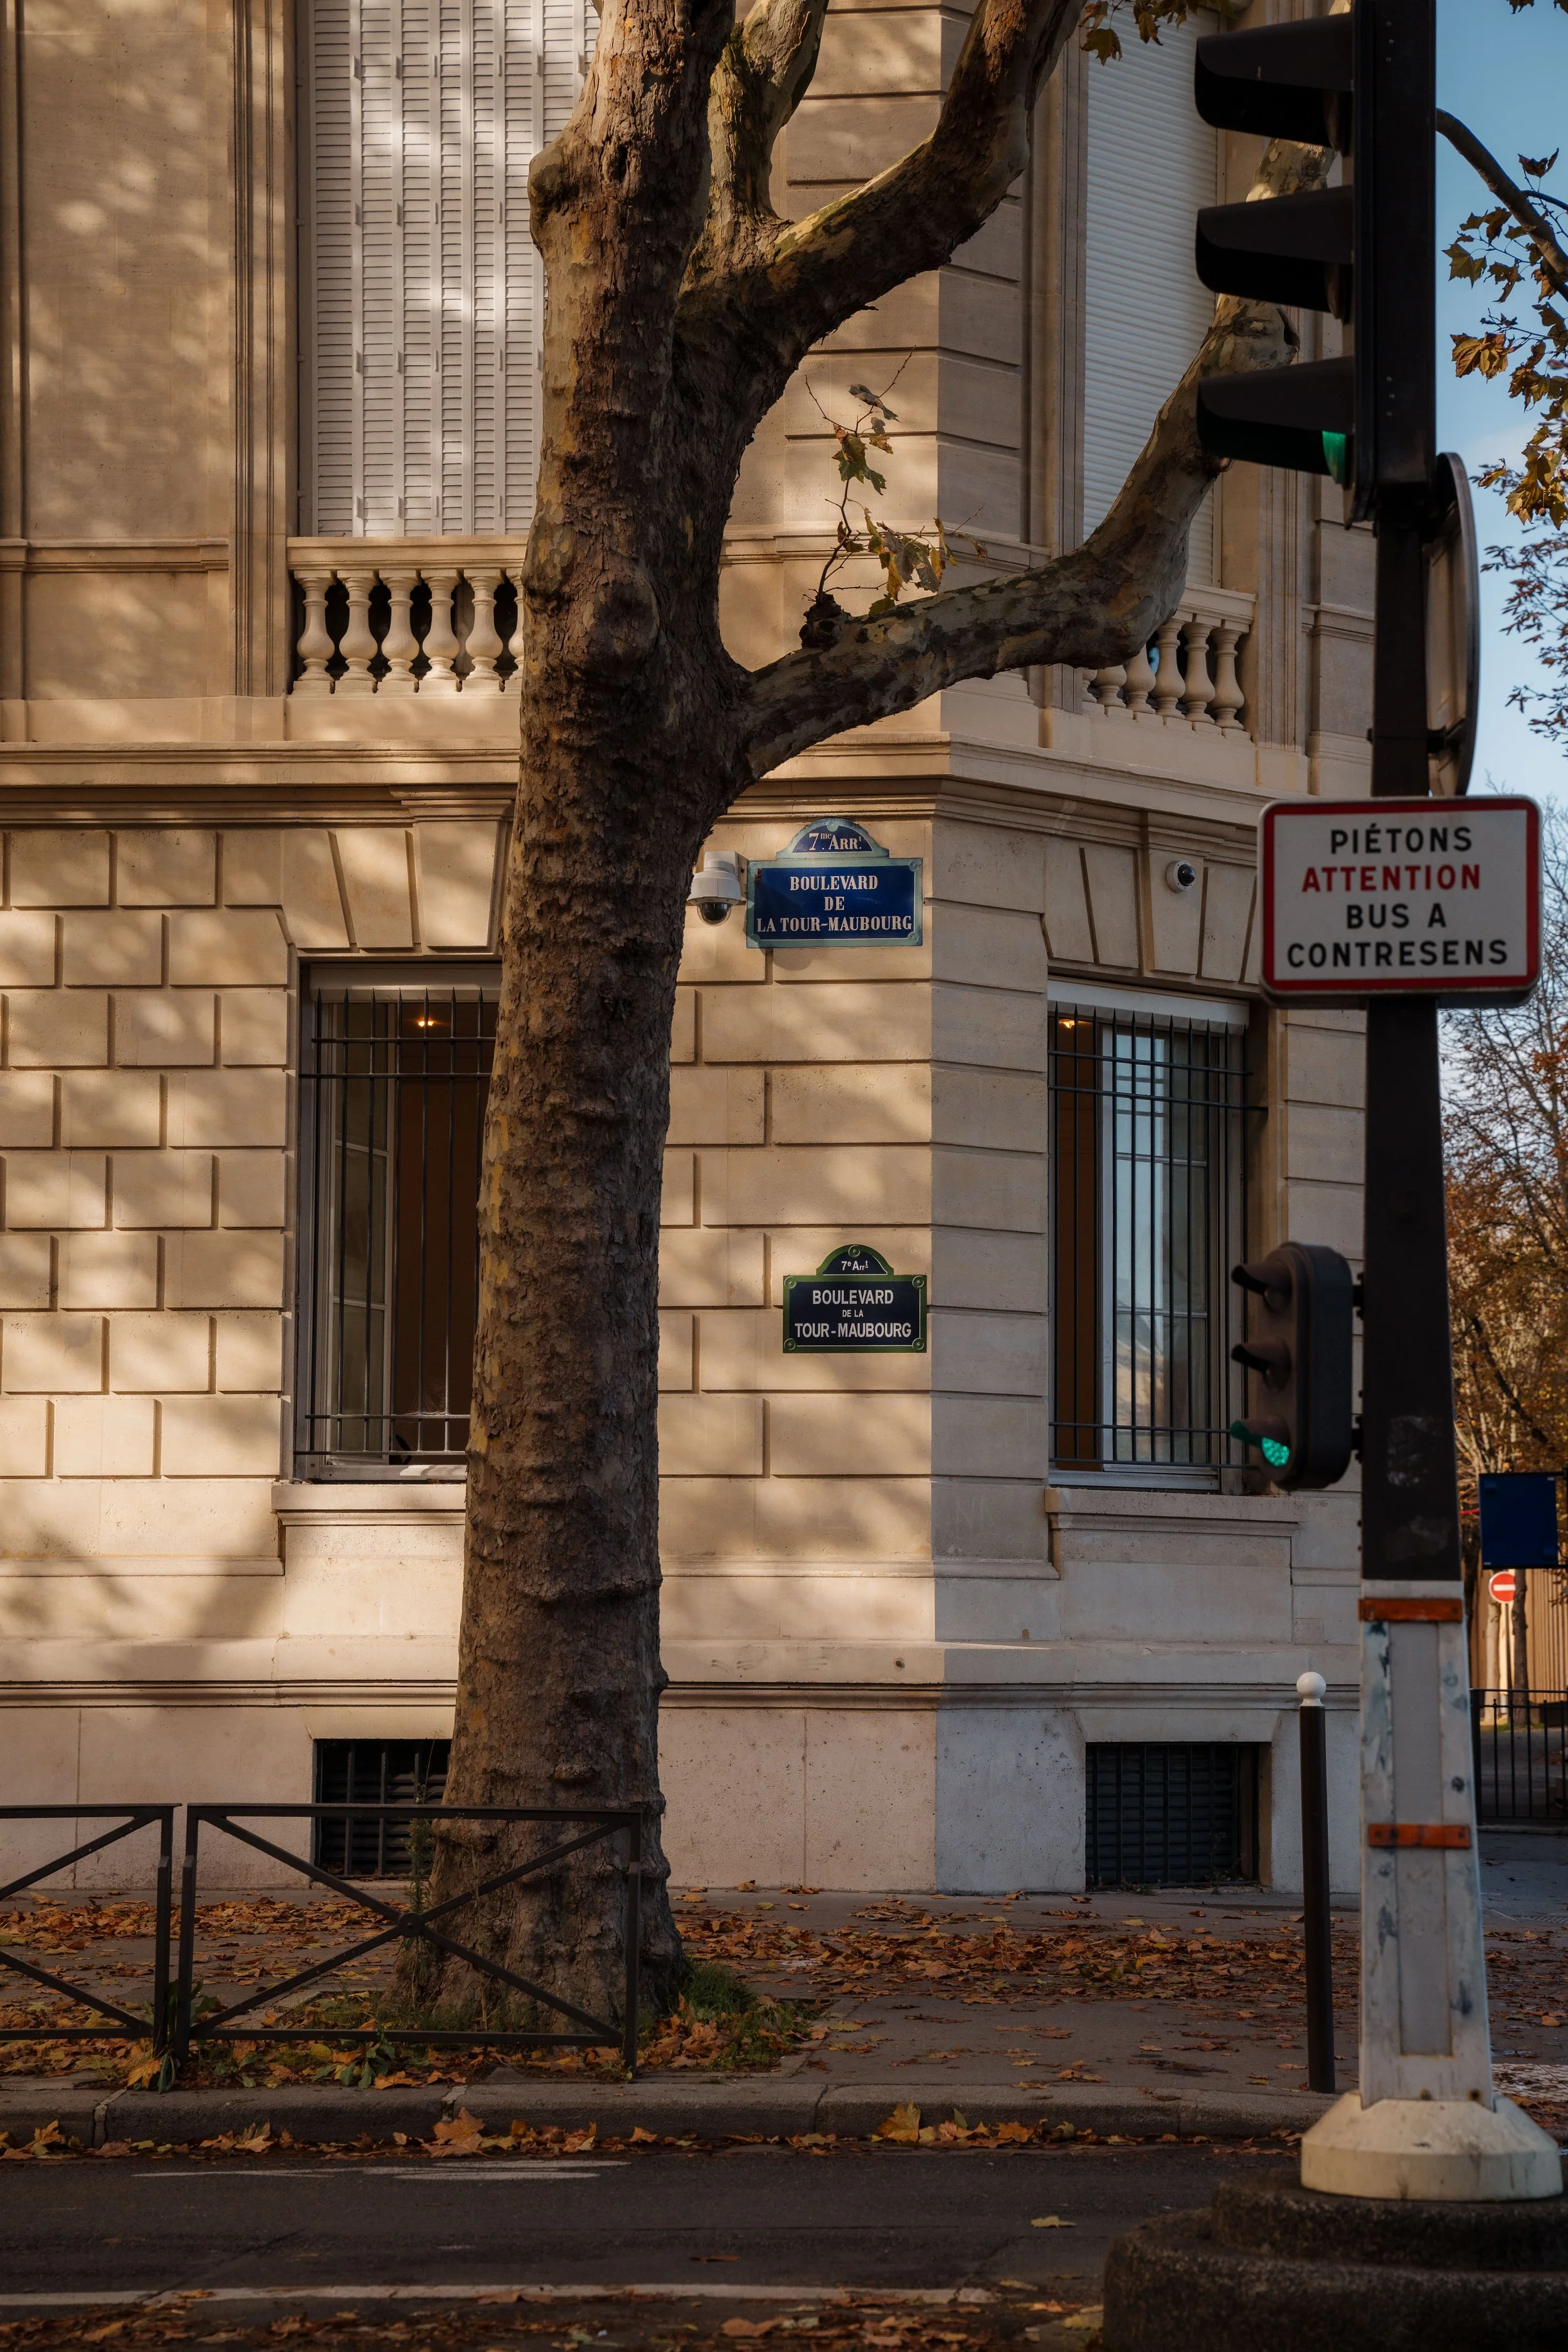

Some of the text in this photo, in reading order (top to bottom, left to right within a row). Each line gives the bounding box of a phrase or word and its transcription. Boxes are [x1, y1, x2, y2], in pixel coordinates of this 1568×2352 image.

[1330, 823, 1472, 854] PIÉTONS
[790, 875, 878, 891] BOULEVARD
[1301, 864, 1480, 893] ATTENTION
[824, 896, 845, 911] DE
[757, 916, 912, 932] LA TOUR-MAUBOURG
[1347, 903, 1446, 930] BUS A
[1288, 940, 1508, 968] CONTRESENS
[812, 1290, 894, 1305] BOULEVARD
